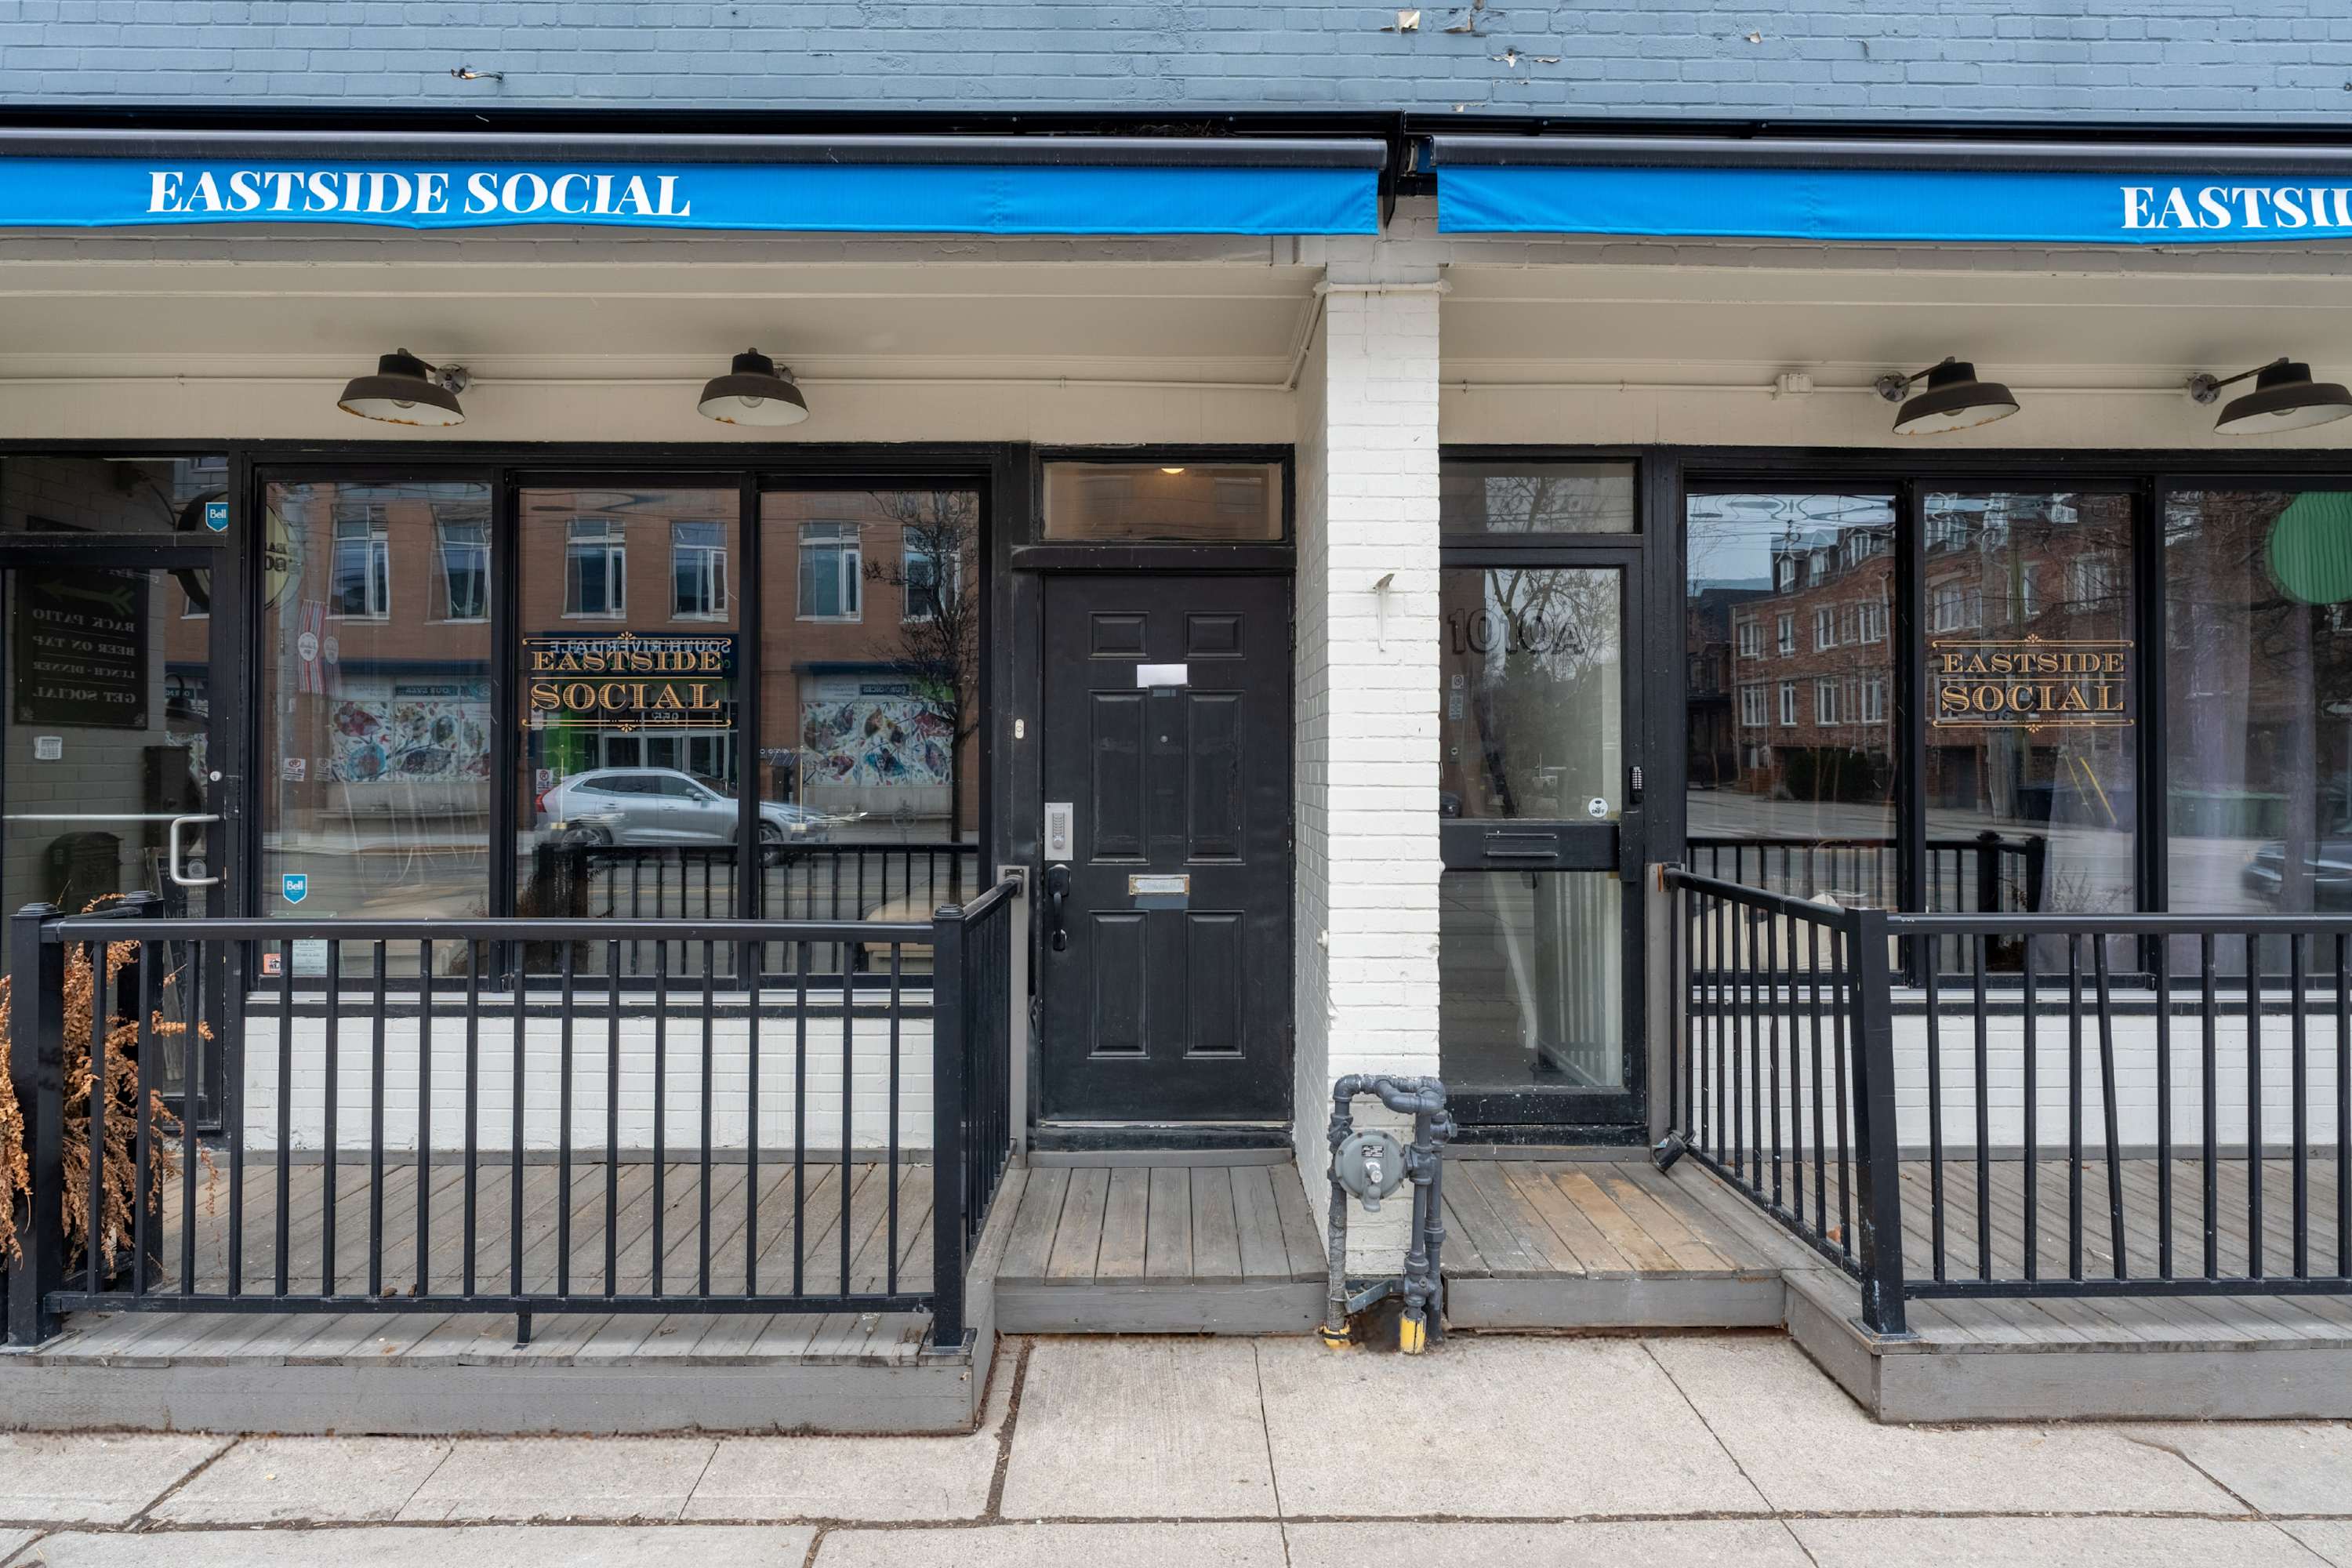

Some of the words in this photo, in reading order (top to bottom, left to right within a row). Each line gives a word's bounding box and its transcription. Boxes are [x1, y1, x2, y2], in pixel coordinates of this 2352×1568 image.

[147, 170, 450, 214] EASTSIDE
[463, 173, 691, 217] SOCIAL
[210, 509, 227, 519] Bell
[531, 651, 722, 672] EASTSIDE
[1941, 652, 2125, 673] EASTSIDE
[531, 683, 721, 711] SOCIAL
[1941, 685, 2125, 712] SOCIAL
[286, 880, 303, 891] Bell
